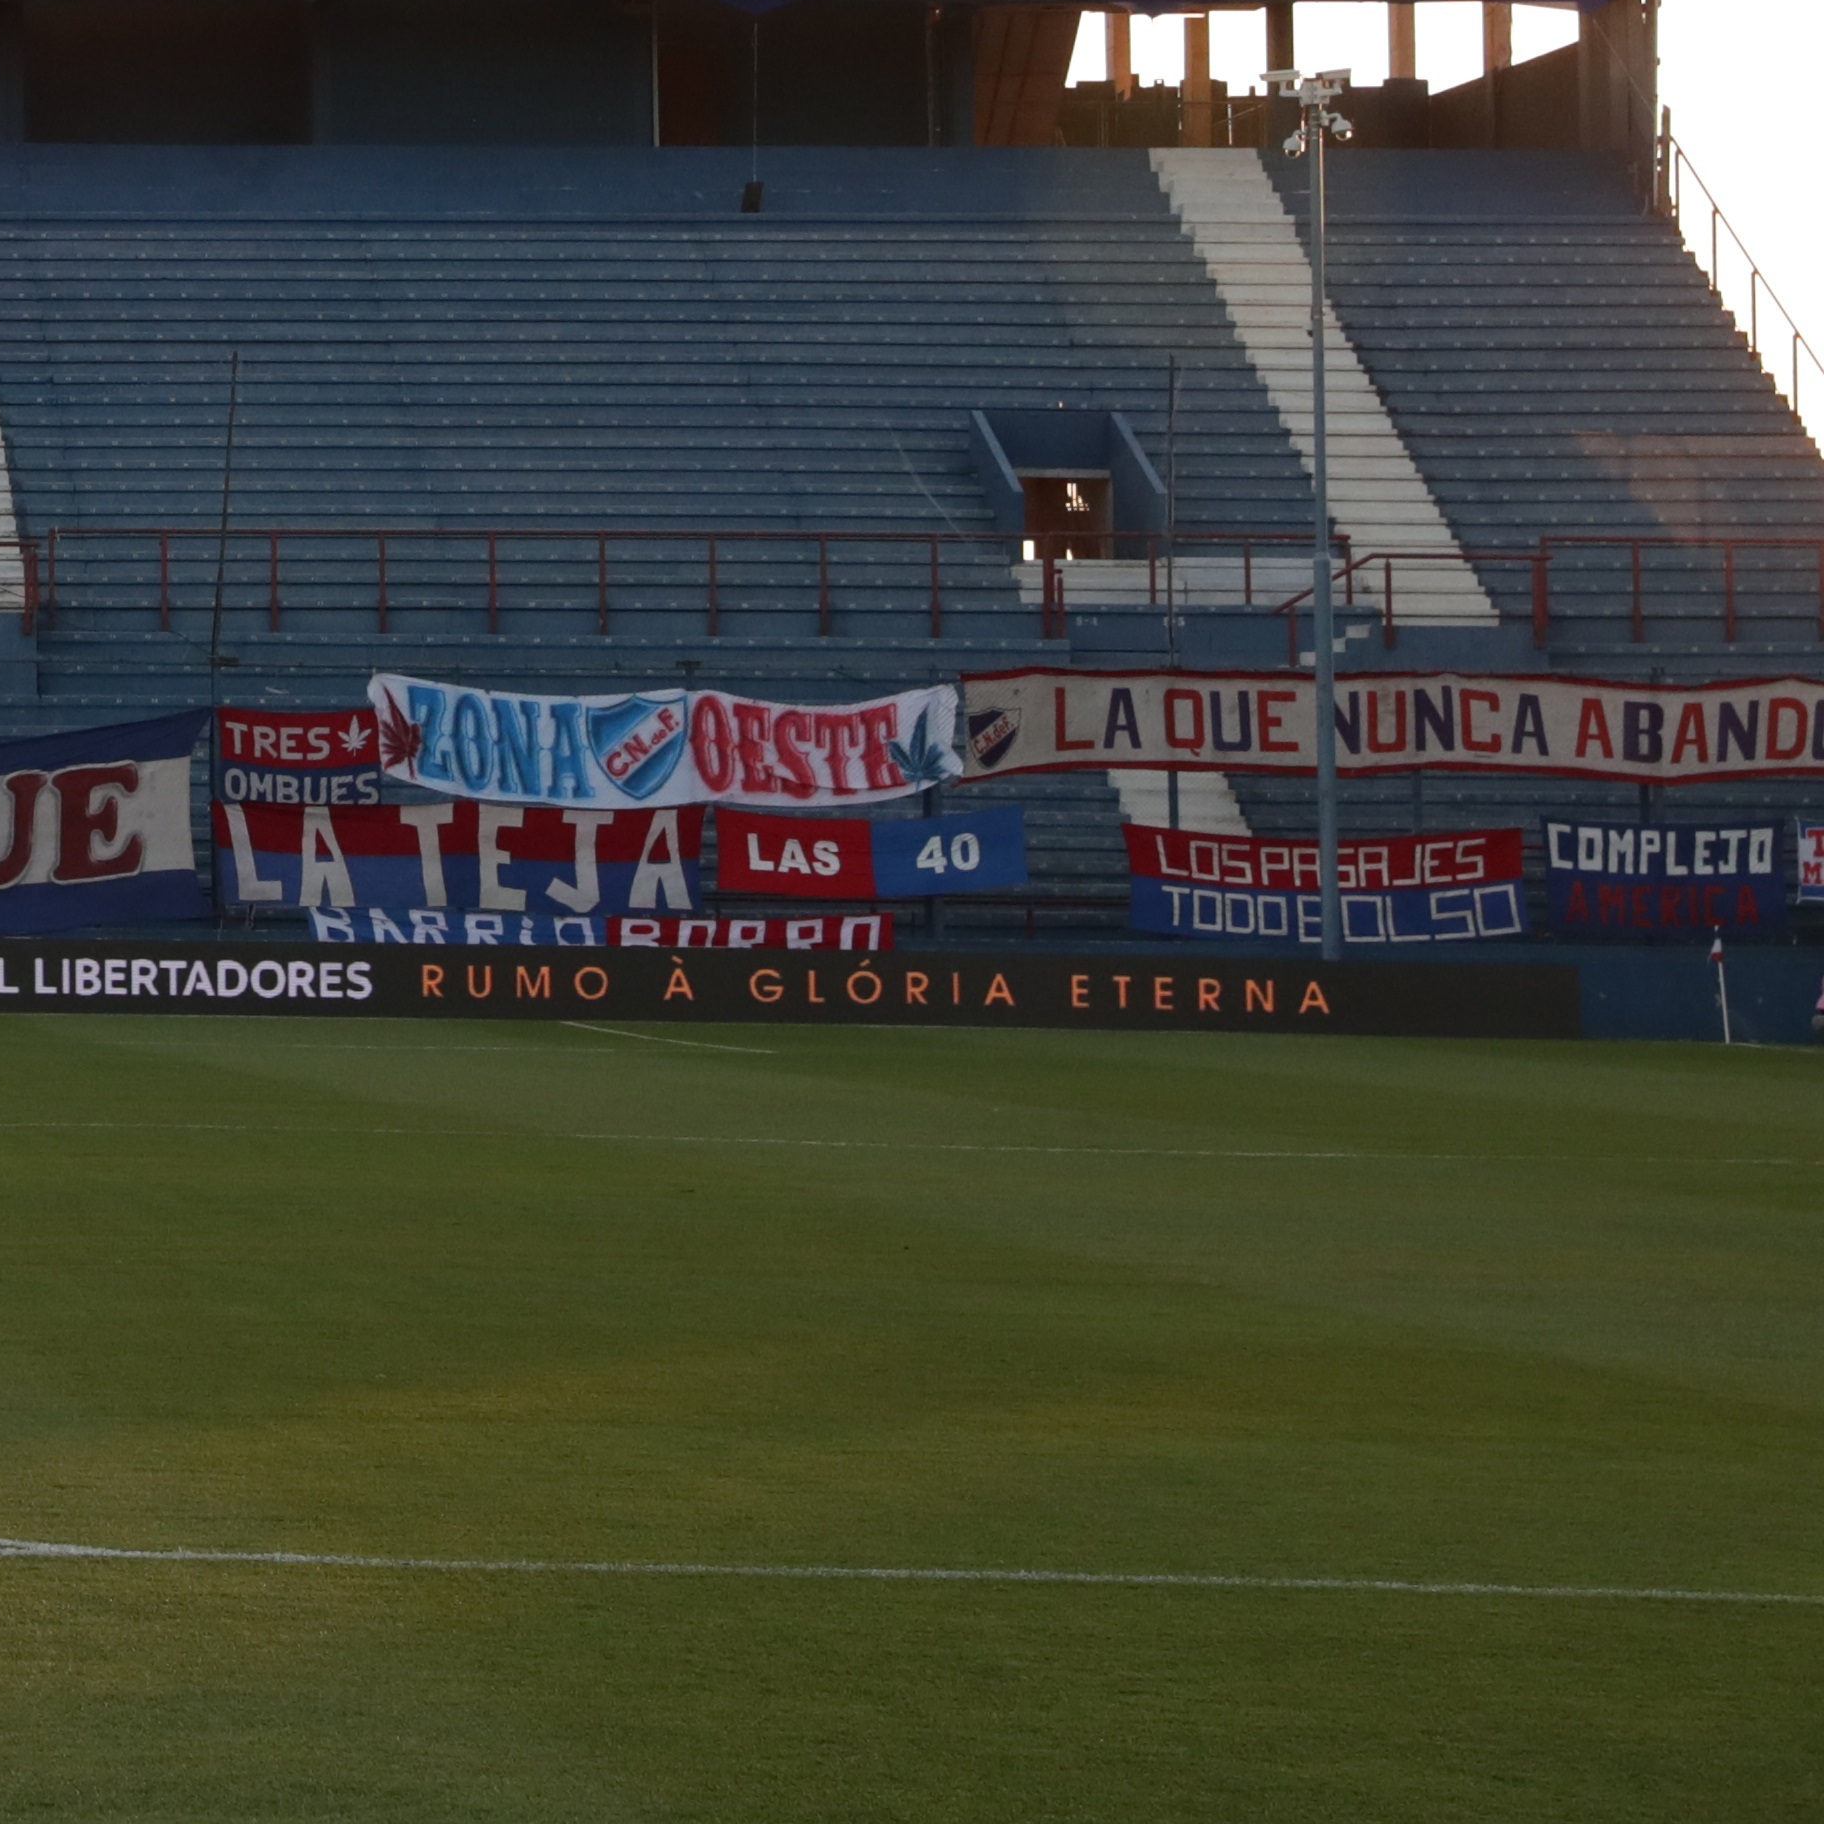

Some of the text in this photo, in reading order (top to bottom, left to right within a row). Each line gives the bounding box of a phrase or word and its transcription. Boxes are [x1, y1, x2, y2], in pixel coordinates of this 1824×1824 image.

[225, 720, 331, 761] TRES
[408, 685, 907, 800] ZONA OESTE
[1054, 686, 1142, 752] LA
[1163, 688, 1300, 757] QUE
[223, 767, 379, 806] OMBUES
[225, 802, 693, 914] LA TEJA
[747, 831, 981, 877] LAS 40
[1155, 834, 1487, 888] LOS PASAJES
[1547, 822, 1774, 876] COMPLEJO
[1161, 882, 1523, 944] TODO BOLSO
[1564, 879, 1760, 928] AMERICA
[33, 957, 374, 1000] LIBERTADORES
[421, 964, 610, 1001] RUMO
[663, 955, 695, 1003] À
[750, 958, 1015, 1008] GLÓRIA
[1070, 973, 1331, 1015] ETERNA
